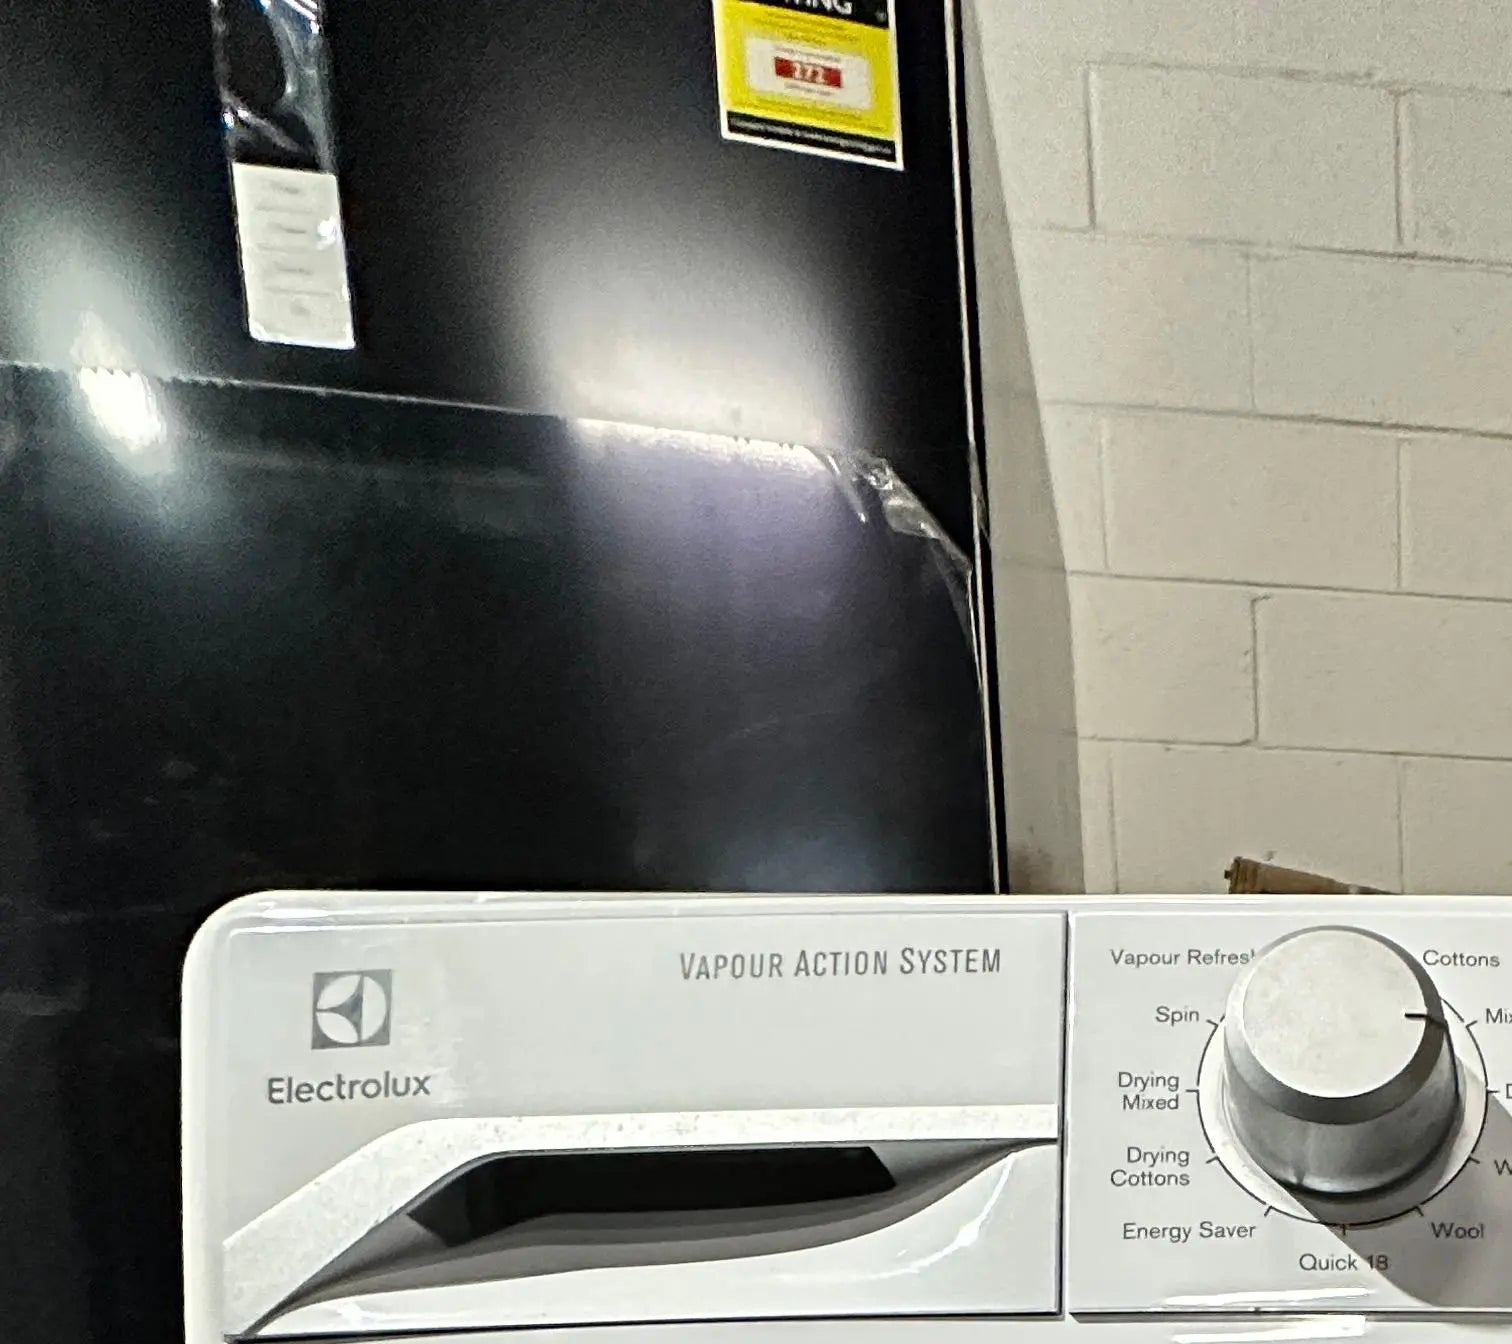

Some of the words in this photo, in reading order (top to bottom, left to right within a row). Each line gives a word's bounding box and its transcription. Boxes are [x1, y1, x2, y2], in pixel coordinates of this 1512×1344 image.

[680, 949, 783, 981] VAPOUR
[795, 948, 888, 978] ACTION
[900, 947, 1001, 976] SYSTEM
[1110, 949, 1181, 968] Vapour
[1423, 950, 1500, 968] Cottons
[1155, 1006, 1200, 1027] Spin
[268, 1071, 431, 1106] Electrolux
[1118, 1072, 1180, 1093] Drying
[1122, 1094, 1180, 1111] Mixed
[1127, 1147, 1190, 1167] Drying
[1110, 1170, 1190, 1187] Cottons
[1123, 1223, 1192, 1243] Energy
[1199, 1222, 1256, 1239] Saver
[1431, 1222, 1484, 1239] Wool
[1299, 1254, 1358, 1272] Quick
[1366, 1255, 1389, 1271] 18
